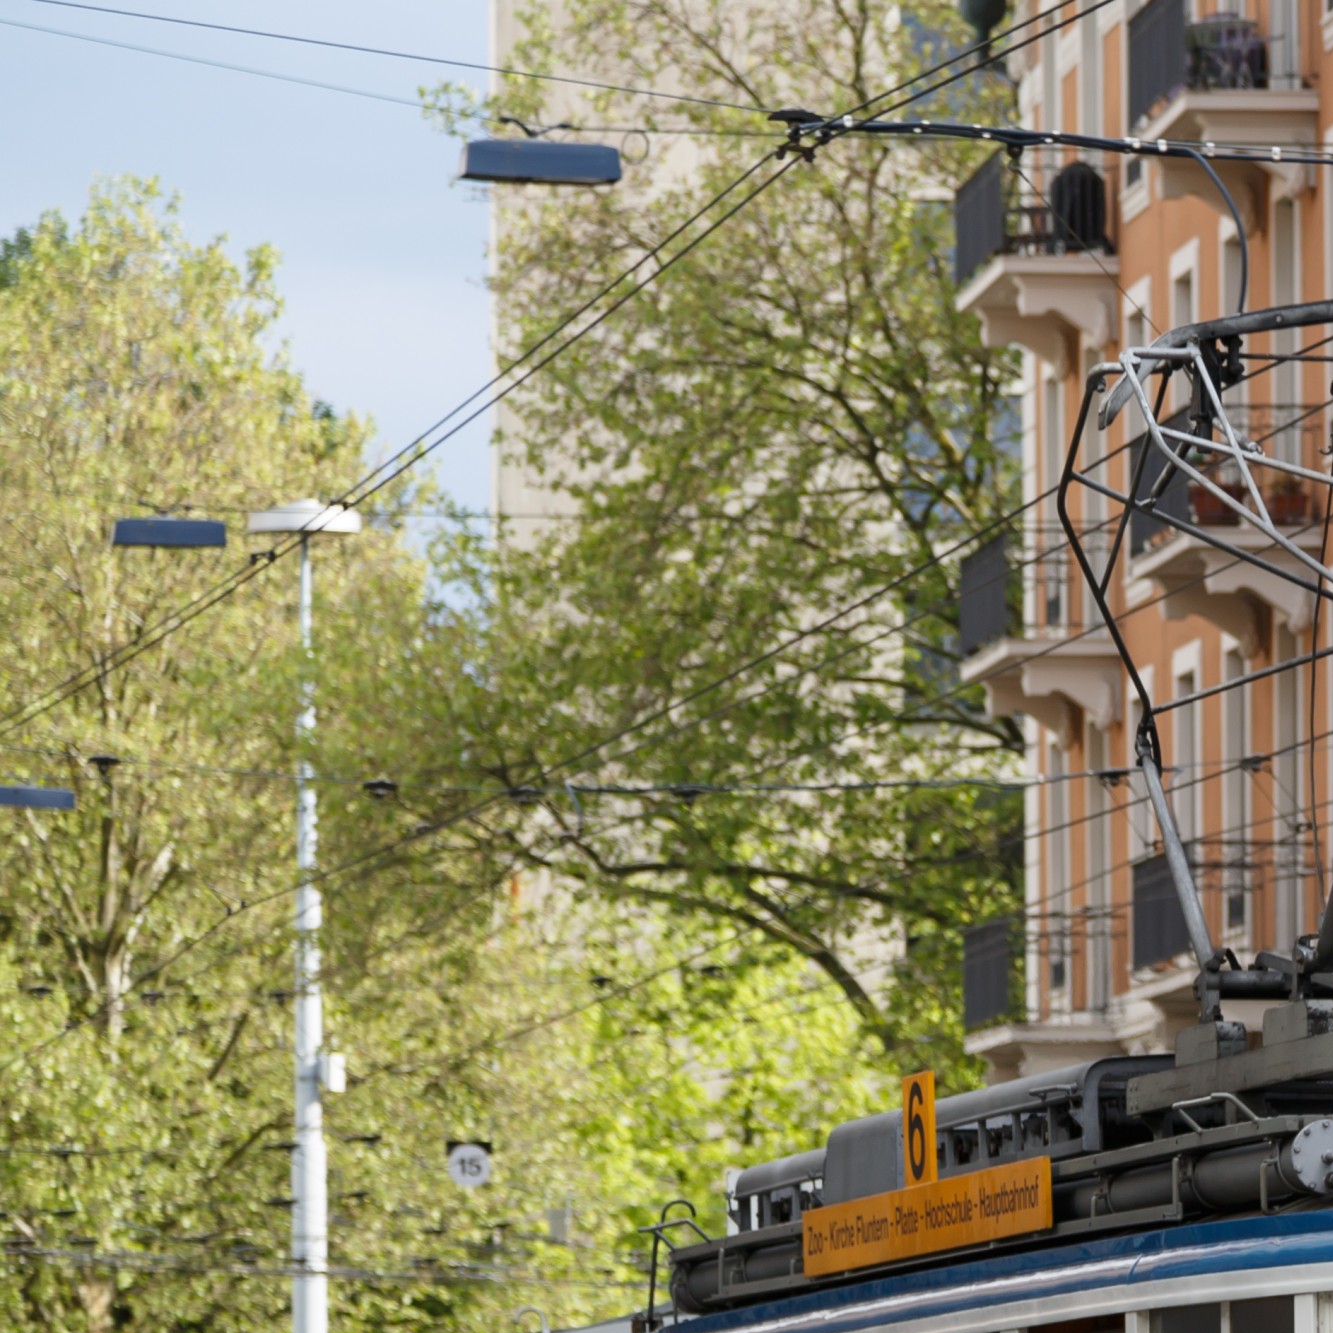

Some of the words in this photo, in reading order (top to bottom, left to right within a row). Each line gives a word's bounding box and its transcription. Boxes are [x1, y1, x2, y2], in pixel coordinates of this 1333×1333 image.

[457, 1155, 481, 1177] 15
[908, 1081, 925, 1181] 6
[807, 1227, 823, 1256] Zoo
[829, 1220, 854, 1250] Kirche
[856, 1214, 888, 1245] Fluntern
[895, 1207, 918, 1237] Platte
[925, 1196, 972, 1231] Hochschule
[979, 1175, 1039, 1225] Hauptbahnhof
